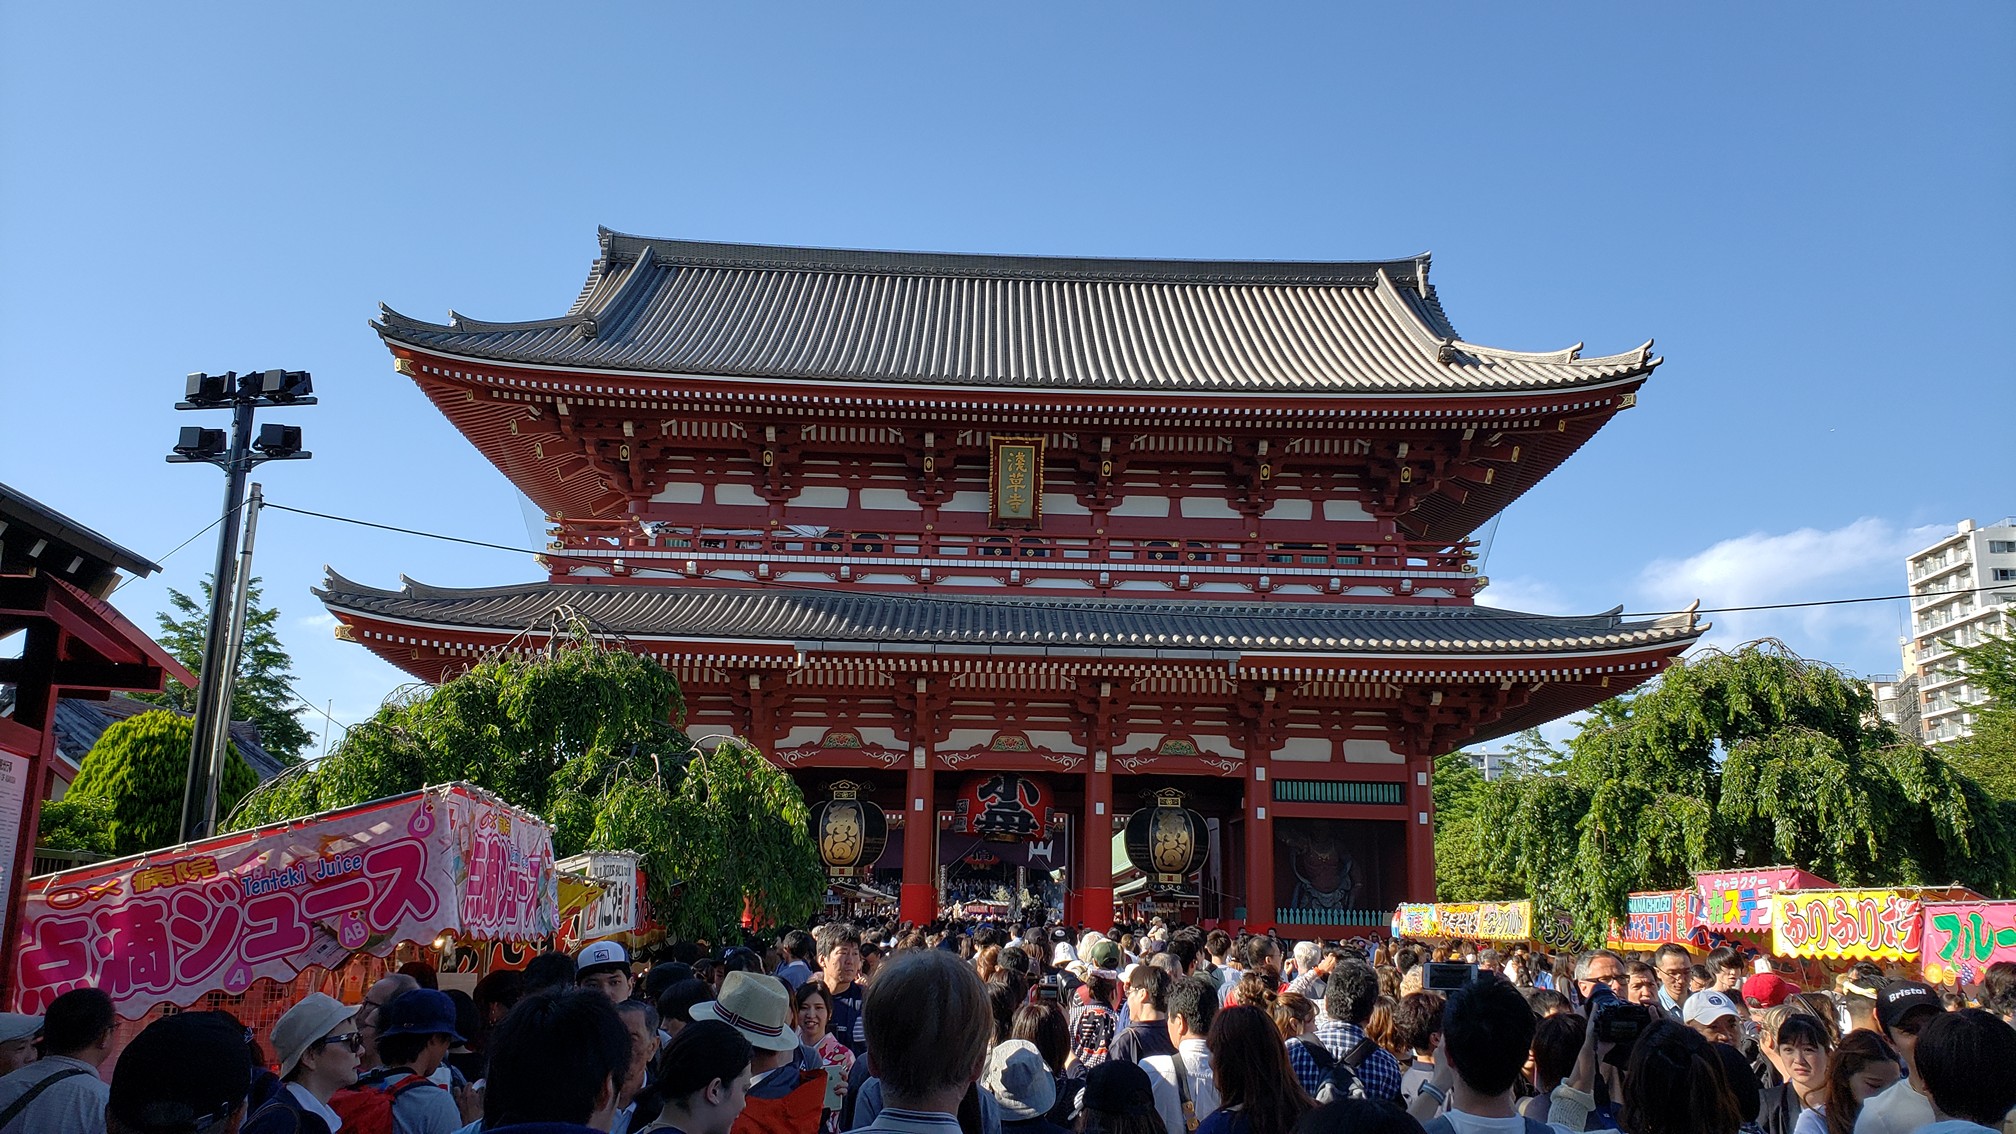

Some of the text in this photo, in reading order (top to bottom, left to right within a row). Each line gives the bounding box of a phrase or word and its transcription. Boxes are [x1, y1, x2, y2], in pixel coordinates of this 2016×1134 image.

[242, 853, 363, 897] Tenteki Juice
[1714, 875, 1767, 890] キャラクター
[1708, 886, 1773, 925] カステラ
[14, 836, 441, 1014] 点滴ジュース
[343, 921, 365, 944] AB
[229, 968, 247, 987] A
[1888, 986, 1927, 1003] Bristol
